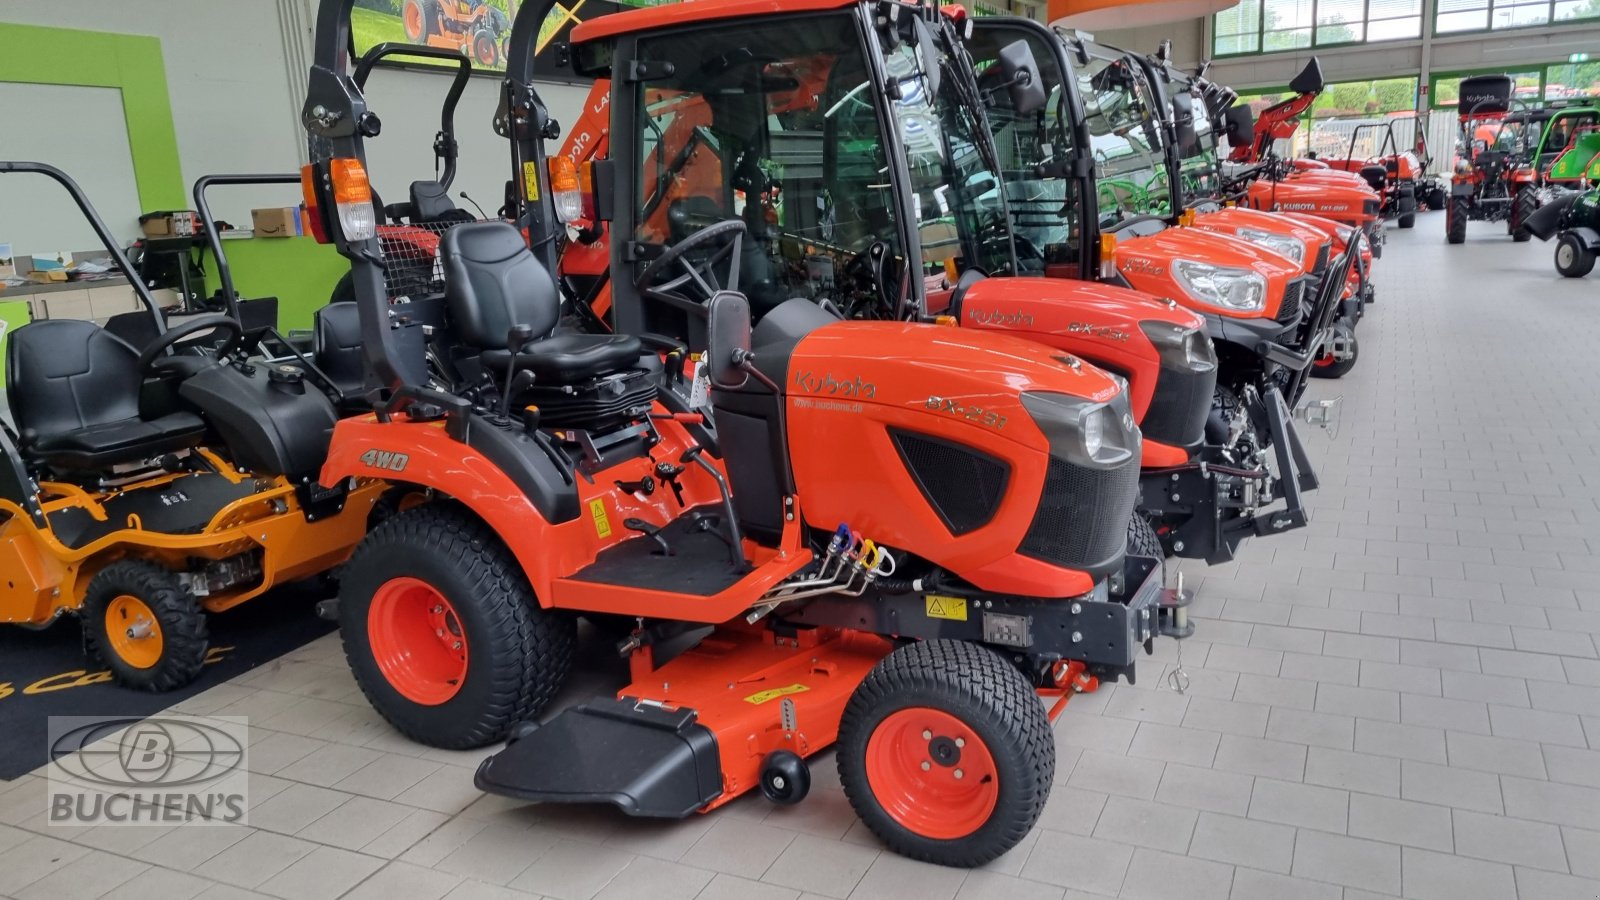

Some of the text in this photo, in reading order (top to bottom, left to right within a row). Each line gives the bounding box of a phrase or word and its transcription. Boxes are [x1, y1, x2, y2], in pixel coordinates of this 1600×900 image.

[1466, 93, 1495, 102] Kubota
[1283, 203, 1316, 211] KUBOTA
[969, 308, 1034, 326] Kubota
[795, 370, 876, 398] Kubota
[925, 395, 1007, 430] BX-231
[359, 448, 410, 472] 4WD
